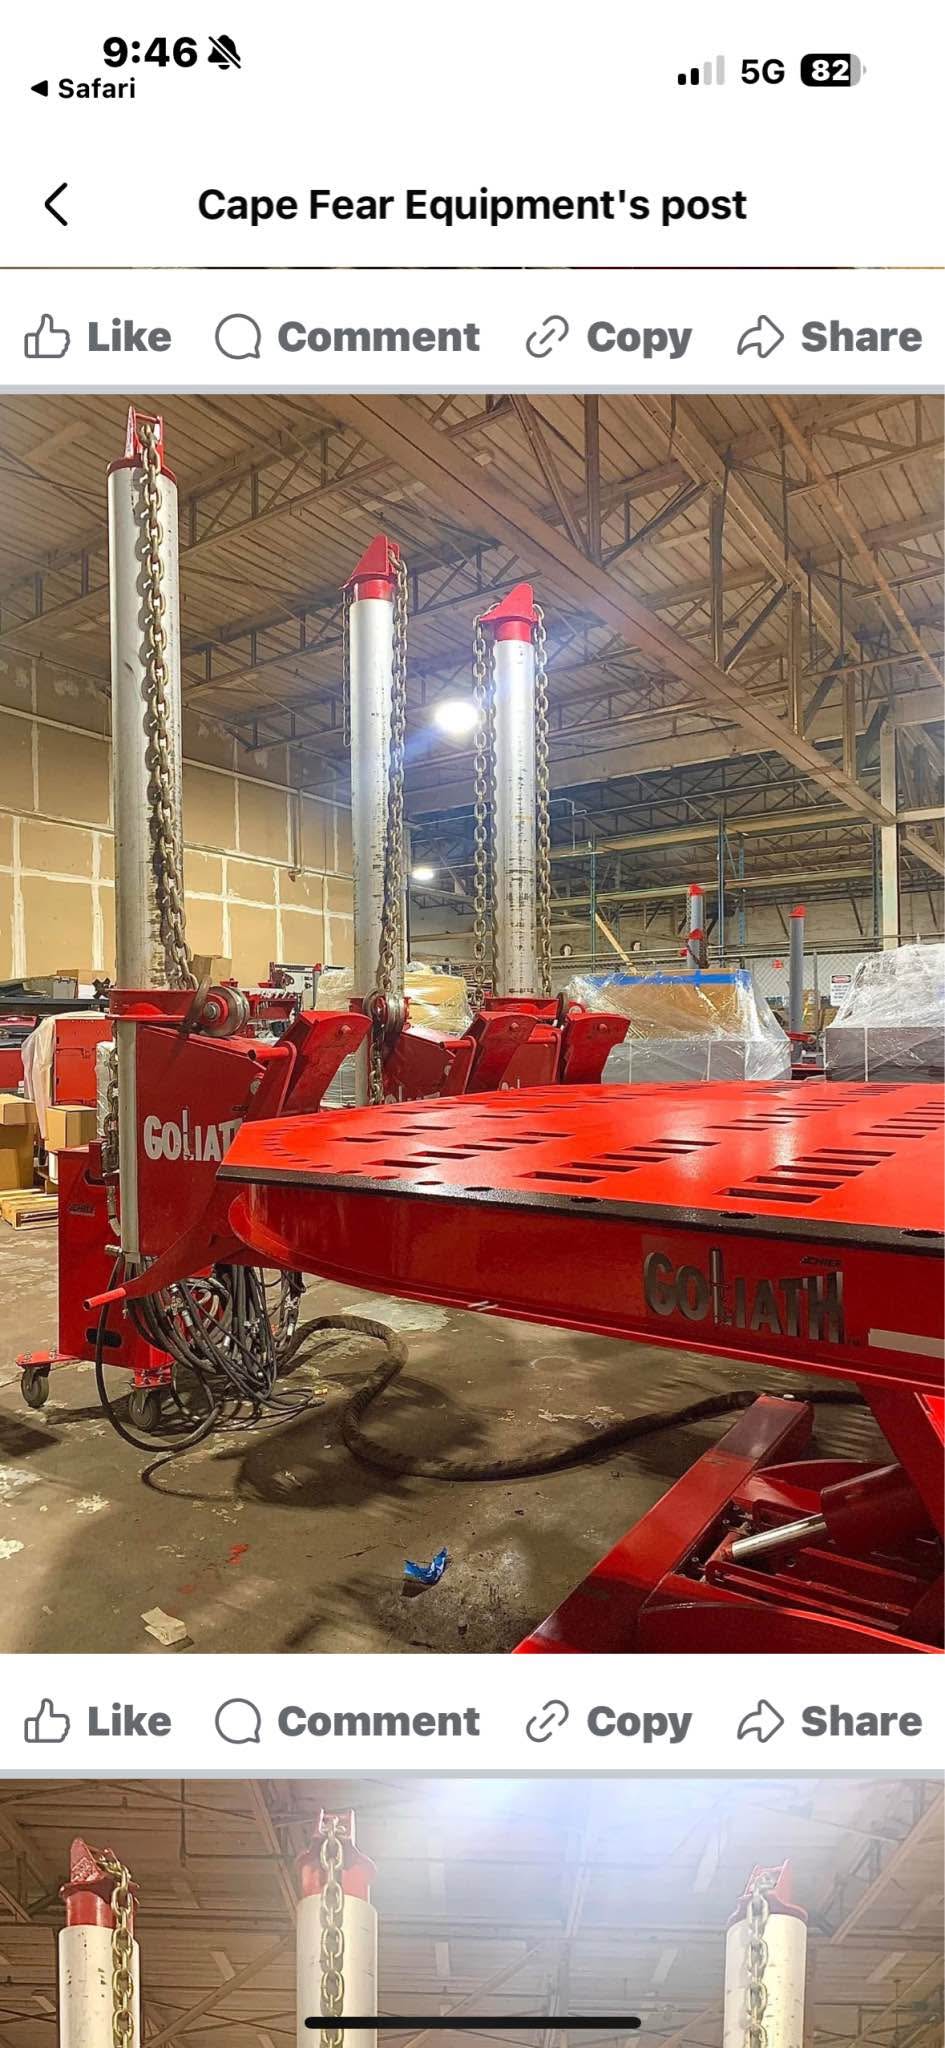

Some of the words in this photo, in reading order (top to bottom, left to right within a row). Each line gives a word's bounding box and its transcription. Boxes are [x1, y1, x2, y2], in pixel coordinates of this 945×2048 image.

[103, 37, 198, 68] 9:46
[741, 59, 785, 84] 5G
[811, 59, 851, 82] 82
[59, 77, 136, 98] Safari
[199, 189, 299, 226] Cape
[310, 190, 394, 220] Fear
[407, 187, 650, 226] Equipment's
[662, 191, 748, 226] post
[88, 318, 172, 352] Like
[278, 321, 480, 353] Comment
[588, 321, 693, 360] Copy
[802, 320, 922, 353] Share
[143, 1109, 243, 1161] GOLIAT
[643, 1249, 845, 1343] GOLIATH
[88, 1703, 172, 1737] Like
[278, 1706, 480, 1738] Comment
[588, 1706, 693, 1745] Copy
[802, 1705, 922, 1738] Share
